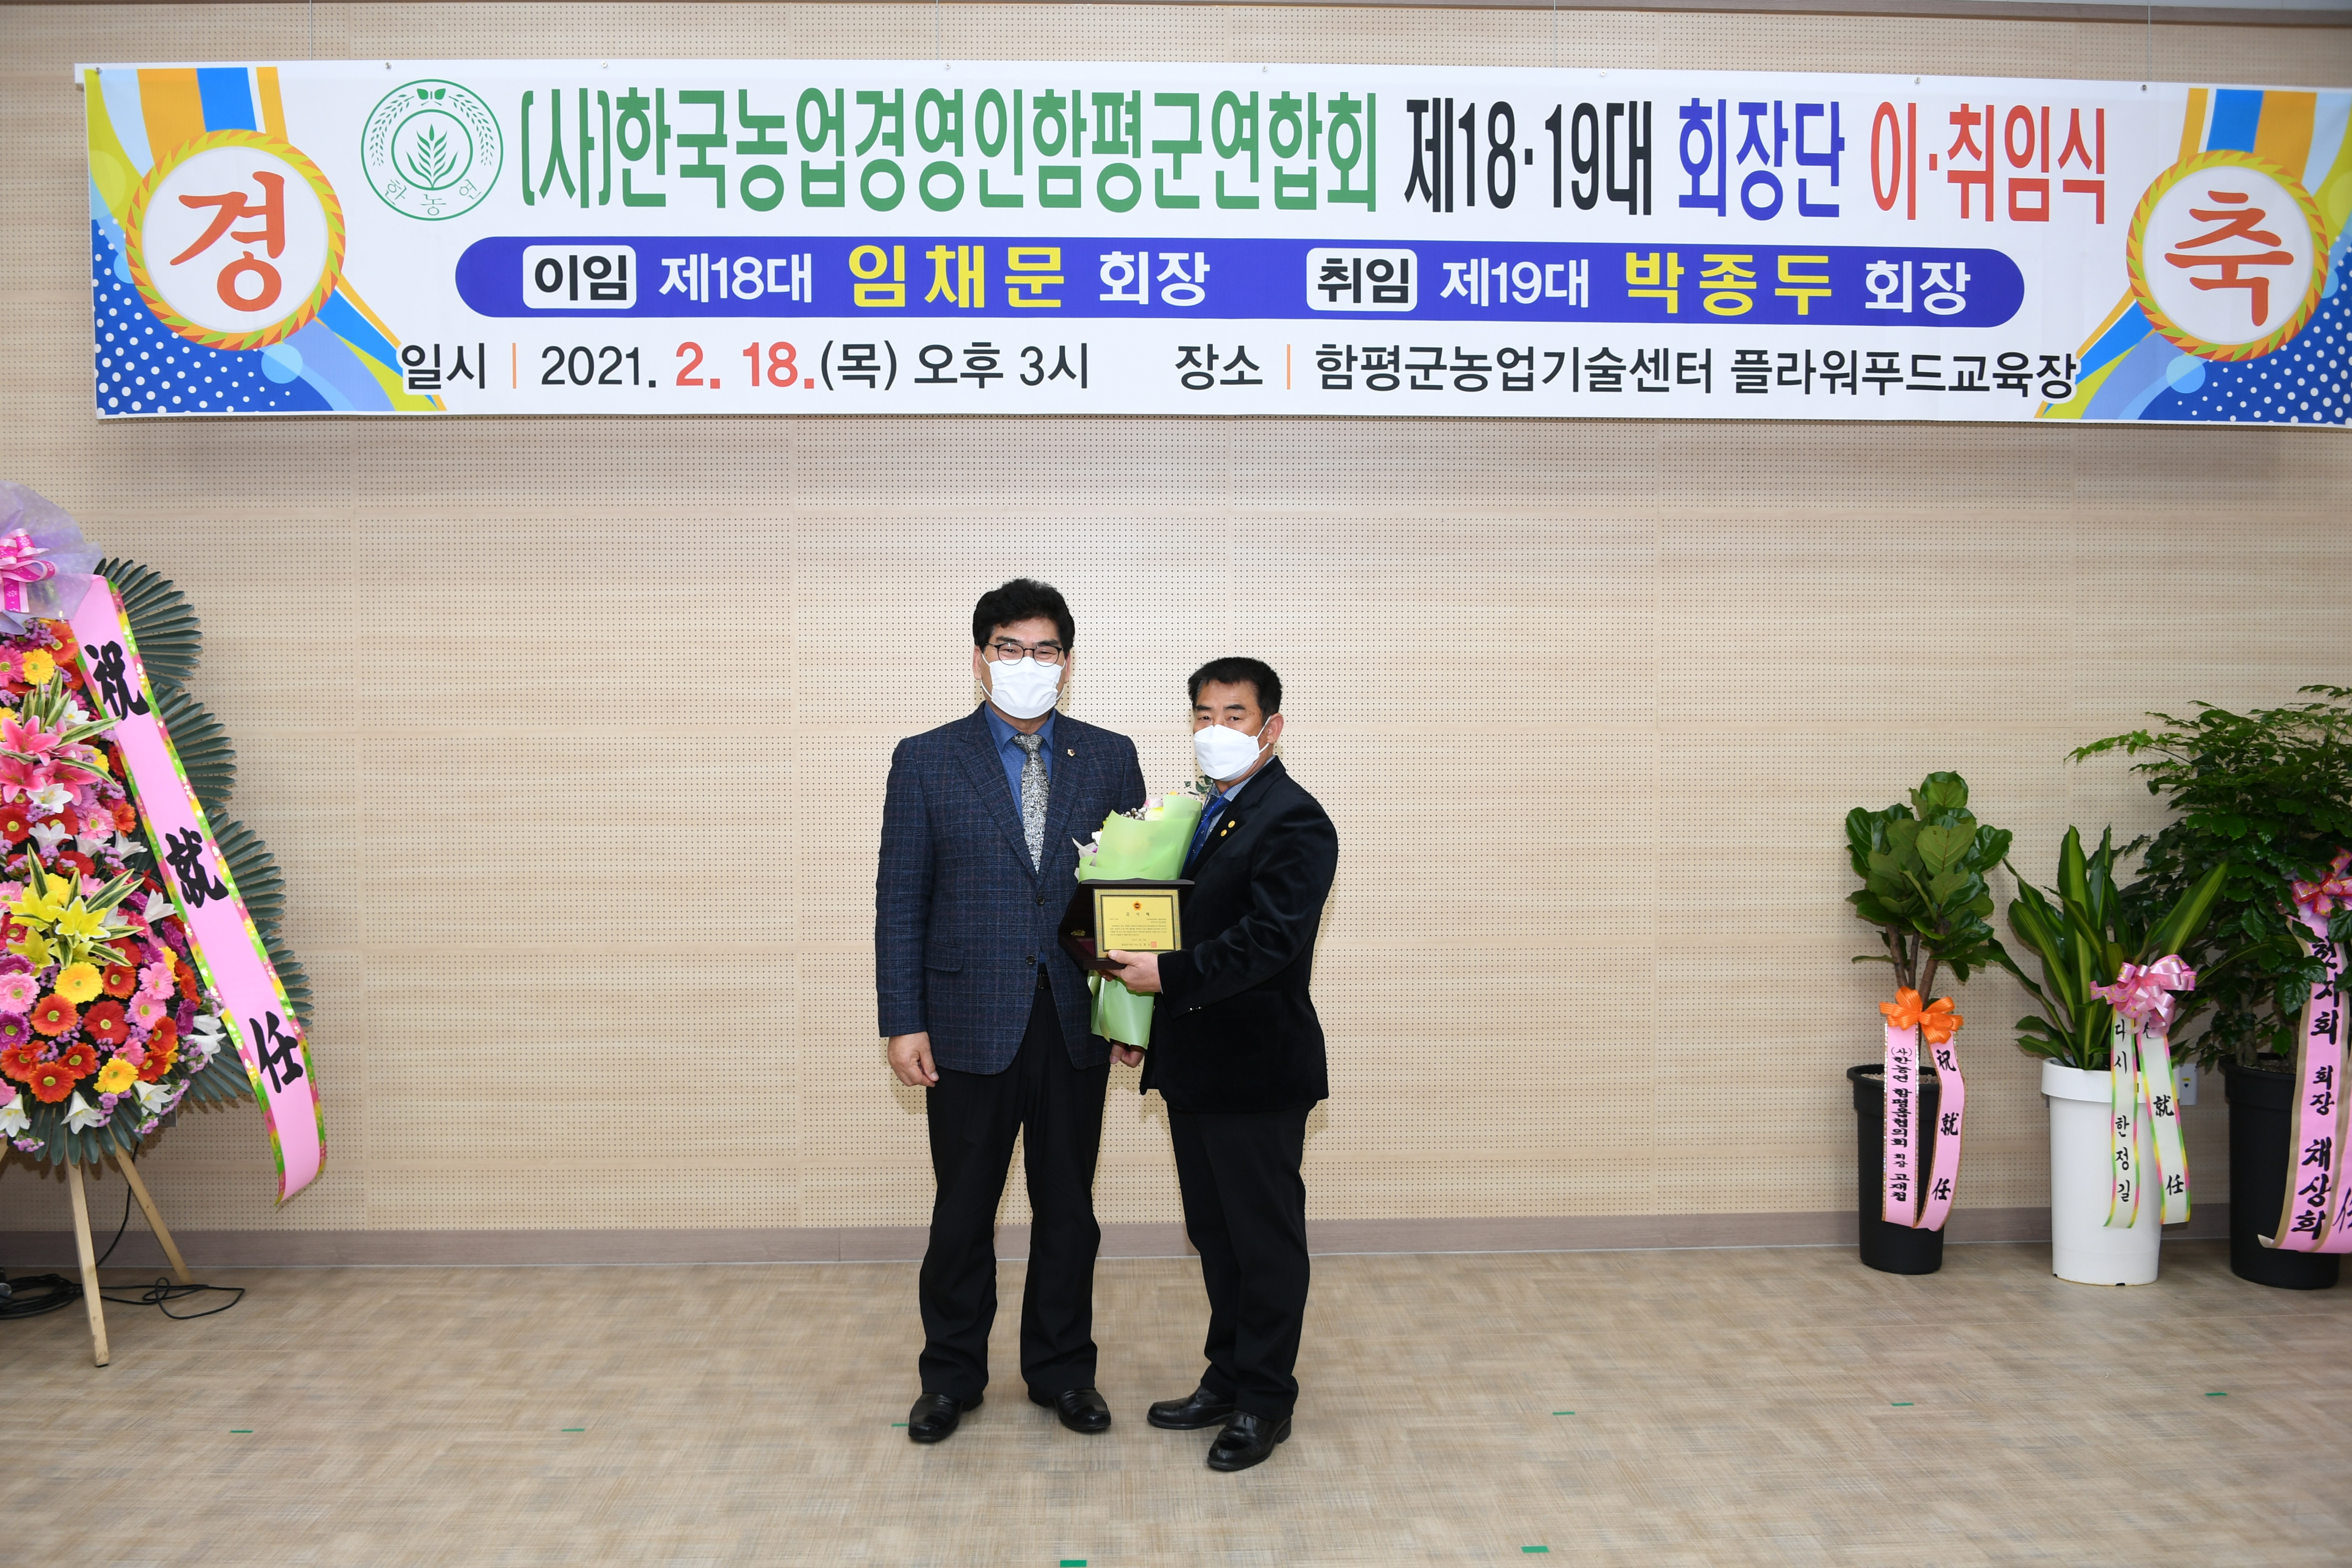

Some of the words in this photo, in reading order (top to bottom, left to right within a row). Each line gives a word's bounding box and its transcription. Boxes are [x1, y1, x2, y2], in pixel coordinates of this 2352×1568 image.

[522, 87, 1376, 212] (사)한국농업경영인함평군연합회
[1404, 98, 1652, 215] 제18·19대
[1679, 98, 1845, 221] 회장단
[1871, 102, 2105, 224] 이·취임식
[382, 178, 482, 216] 한농연
[170, 171, 286, 312] 경
[2164, 190, 2295, 328] 축
[535, 255, 626, 300] 이임
[659, 253, 811, 302] 제18대
[849, 245, 1064, 307] 임채문
[1100, 251, 1210, 306] 회장
[1318, 258, 1408, 303] 취임
[1440, 258, 1588, 308] 제19대
[1626, 252, 1832, 315] 박종두
[1865, 260, 1971, 315] 회장
[402, 343, 485, 389] 일시
[542, 346, 656, 388] 2021.
[676, 342, 721, 389] 2.
[915, 342, 1003, 389] 오후
[1020, 343, 1087, 389] 3시
[1176, 344, 1263, 390] 장소
[1316, 344, 1711, 393] 함평군농업기술센터
[1731, 349, 2076, 399] 플라워푸드교육장
[2309, 1065, 2335, 1116] 회장
[1893, 1153, 1908, 1168] 회장
[2115, 1114, 2130, 1203] 한정길
